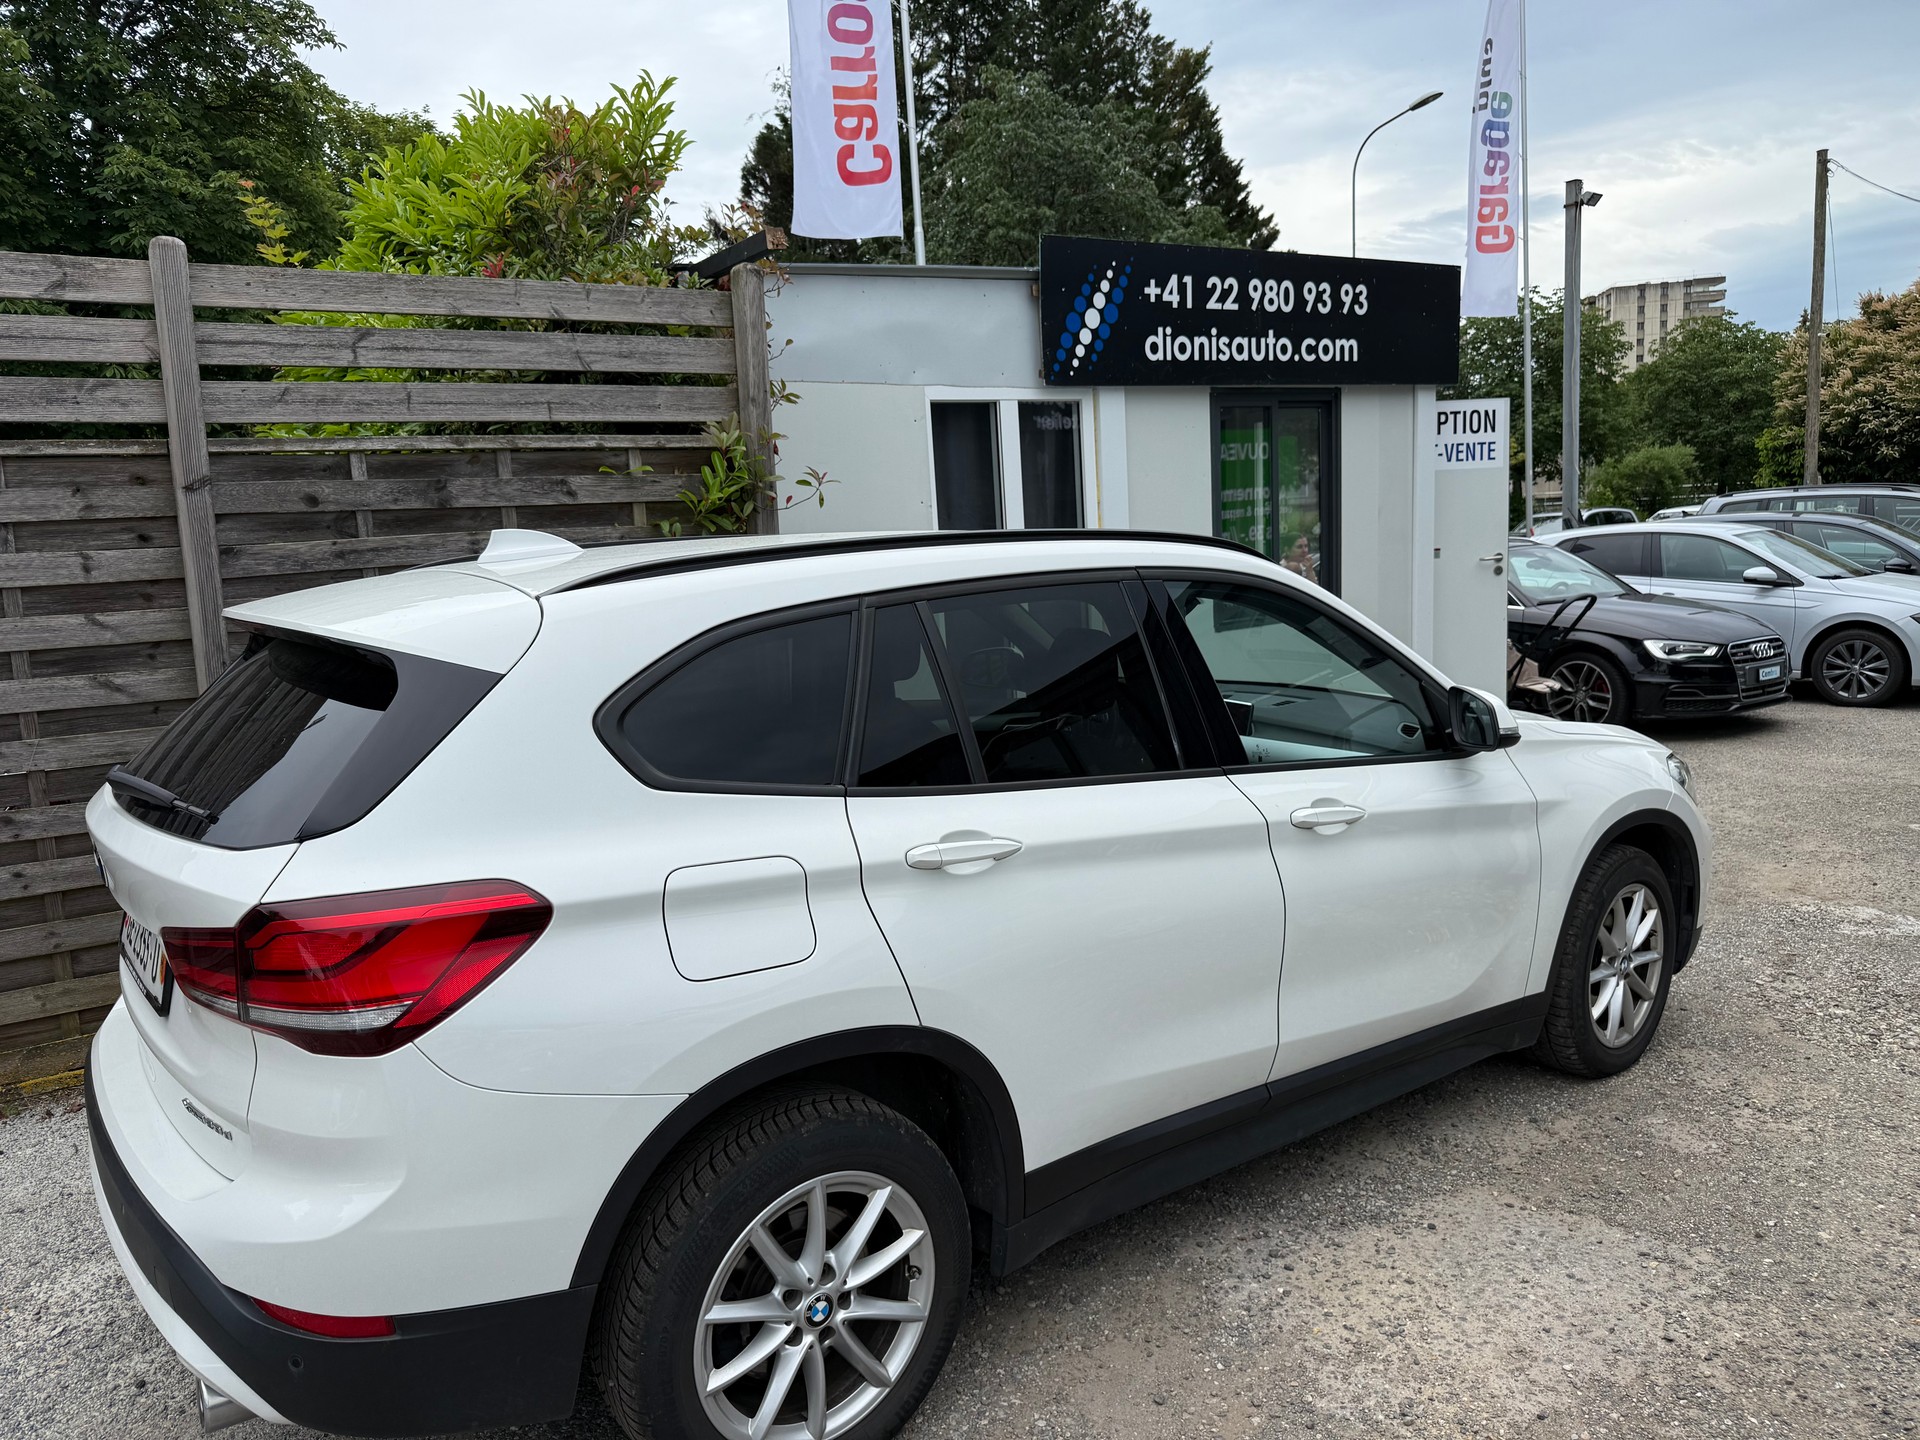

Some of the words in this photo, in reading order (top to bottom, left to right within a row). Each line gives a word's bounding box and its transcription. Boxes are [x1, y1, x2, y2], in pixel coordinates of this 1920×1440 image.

[1144, 273, 1193, 309] +41
[1205, 276, 1239, 311] 22
[1248, 278, 1295, 313] 980
[1303, 281, 1332, 315] 93
[1340, 283, 1368, 316] 93
[1144, 326, 1358, 362] dionisauto.com
[1436, 409, 1496, 435] PTION
[1435, 441, 1496, 462] -VENTE
